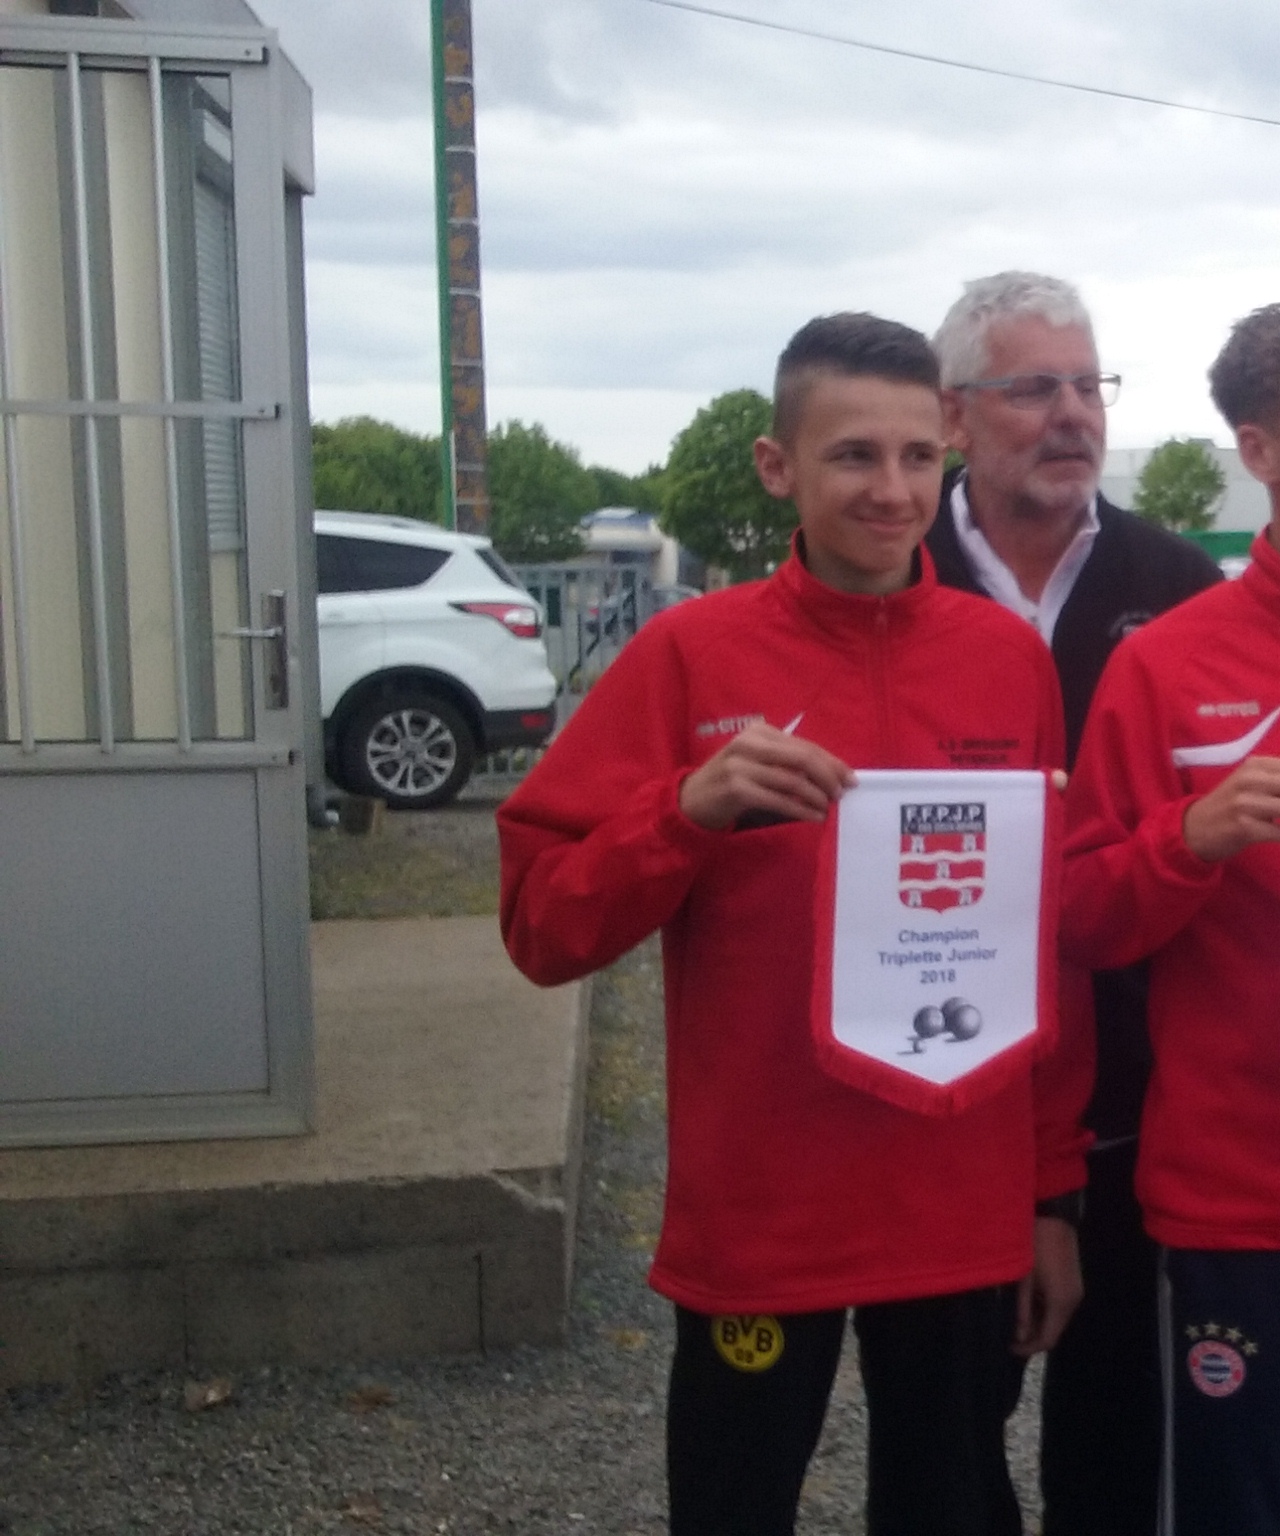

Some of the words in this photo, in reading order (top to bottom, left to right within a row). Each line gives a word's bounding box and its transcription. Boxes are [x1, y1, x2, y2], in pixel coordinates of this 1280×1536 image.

[898, 928, 979, 944] Champion
[878, 950, 942, 967] Triplette
[947, 947, 998, 962] Junior
[920, 968, 957, 984] 2018
